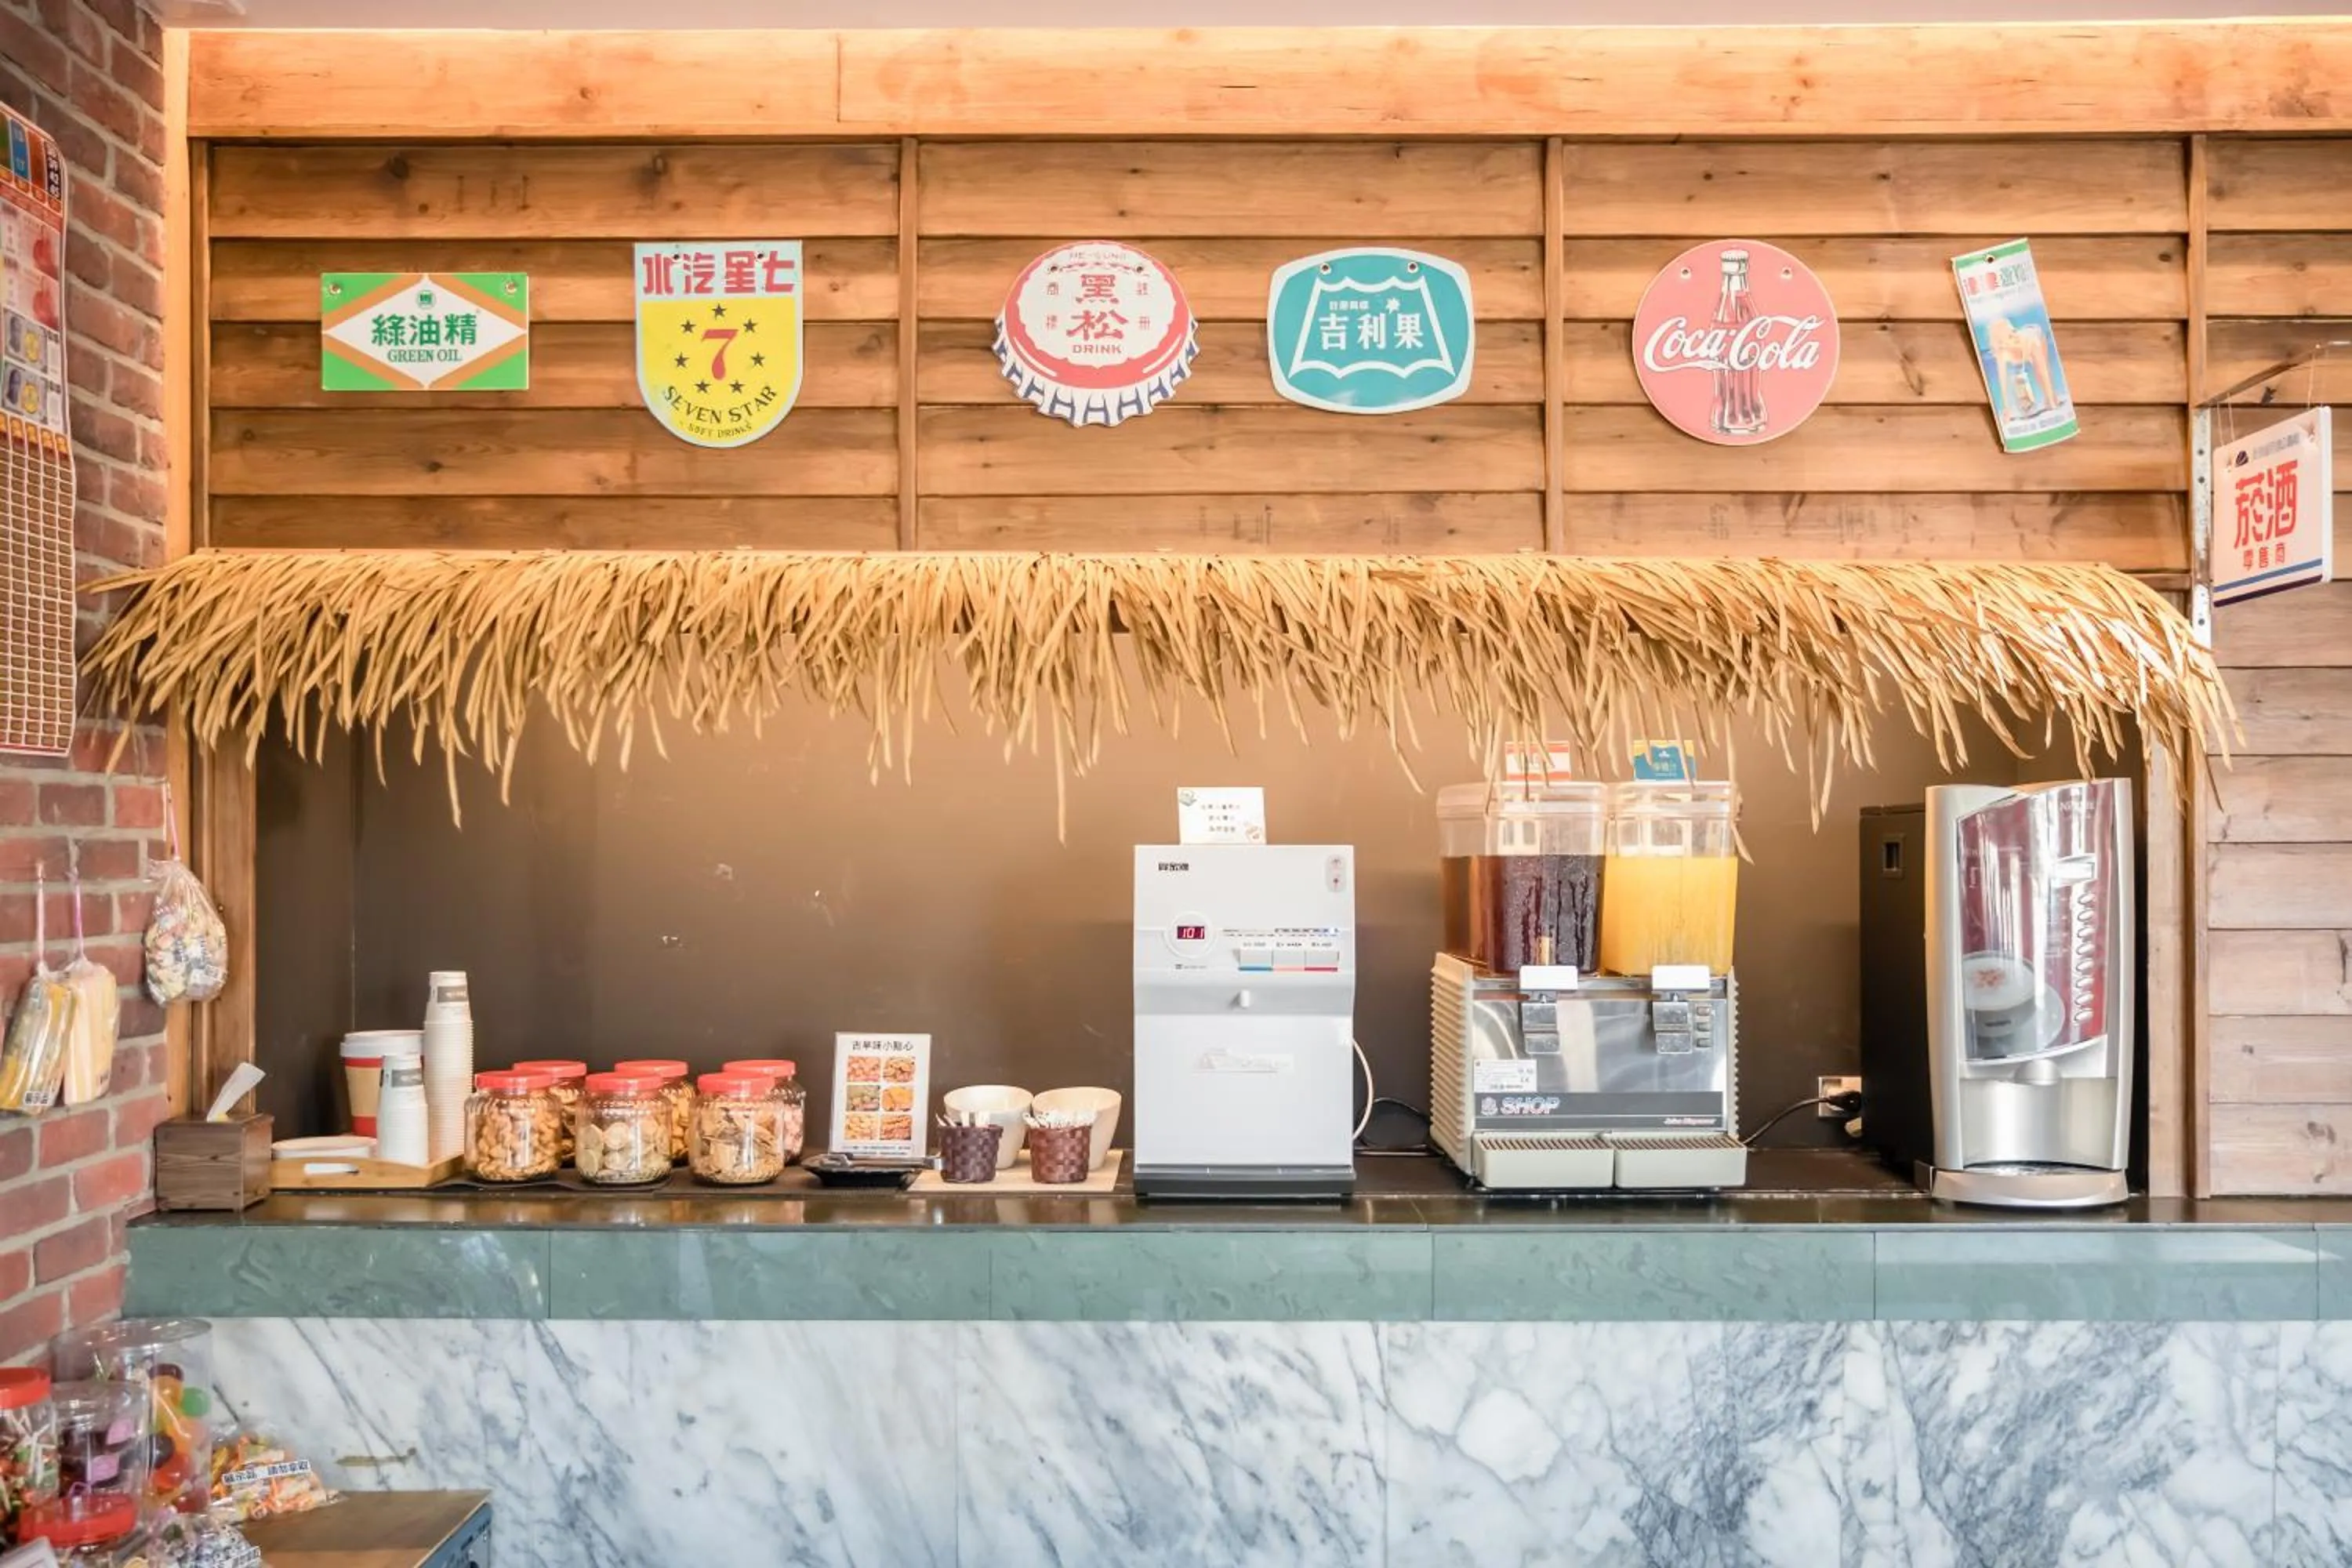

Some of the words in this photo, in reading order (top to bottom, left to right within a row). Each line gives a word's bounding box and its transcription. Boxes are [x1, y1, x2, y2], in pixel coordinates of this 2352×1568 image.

[371, 313, 477, 347] 綠油精
[1318, 313, 1425, 350] 吉利果
[387, 349, 434, 363] GREEN
[437, 349, 463, 362] OIL
[700, 328, 739, 381] 7
[1072, 344, 1123, 354] DRINK
[662, 385, 723, 424] SEVEN
[728, 384, 778, 423] STAR
